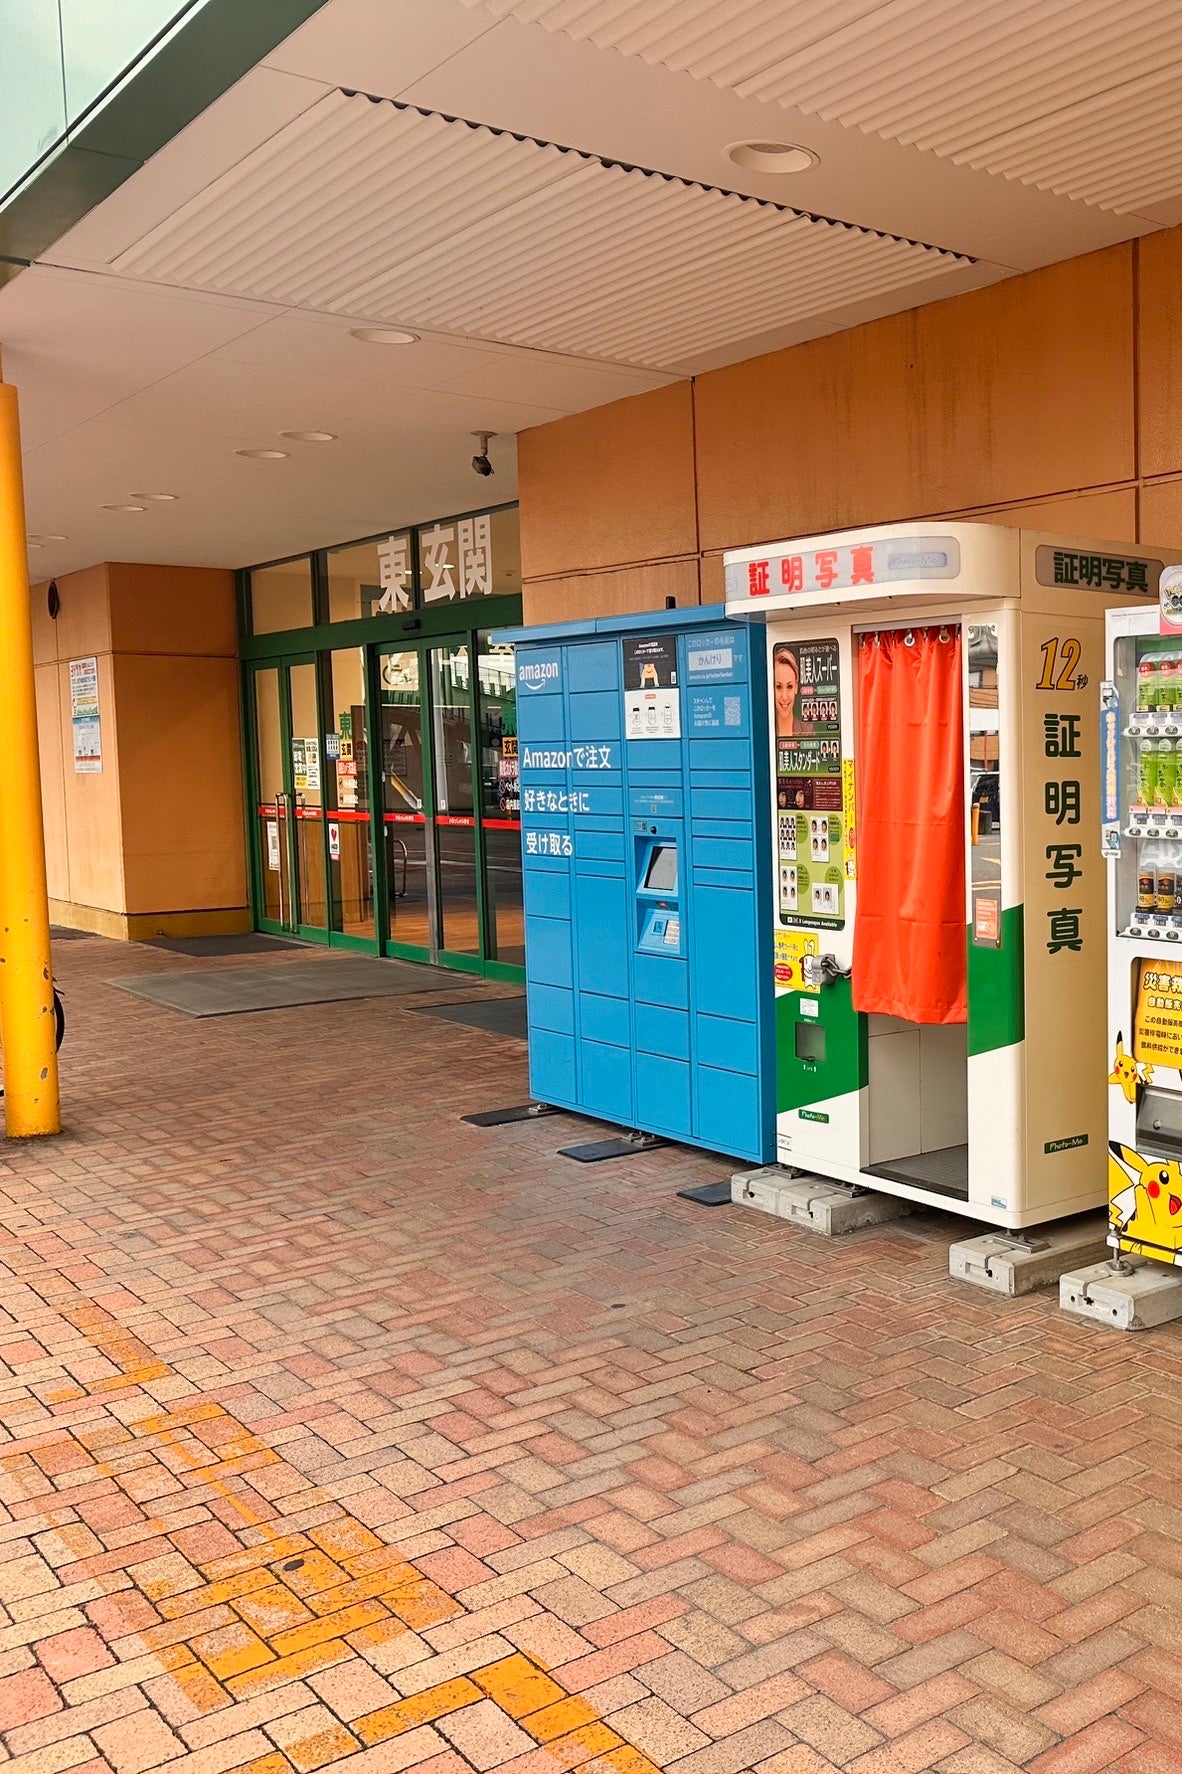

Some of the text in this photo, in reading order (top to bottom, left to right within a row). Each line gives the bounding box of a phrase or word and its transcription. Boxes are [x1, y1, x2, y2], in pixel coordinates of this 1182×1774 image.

[377, 515, 492, 611] 東玄関
[748, 546, 875, 597] 証明写真
[1053, 551, 1149, 593] 証明写真
[519, 662, 559, 681] amazon
[1035, 636, 1089, 691] 12秒
[523, 745, 611, 768] Amazonで注文
[524, 790, 590, 812] 好きなときに
[526, 832, 573, 856] 受け取る
[1044, 713, 1083, 955] 証明写真
[1049, 1138, 1083, 1152] Photo-Me
